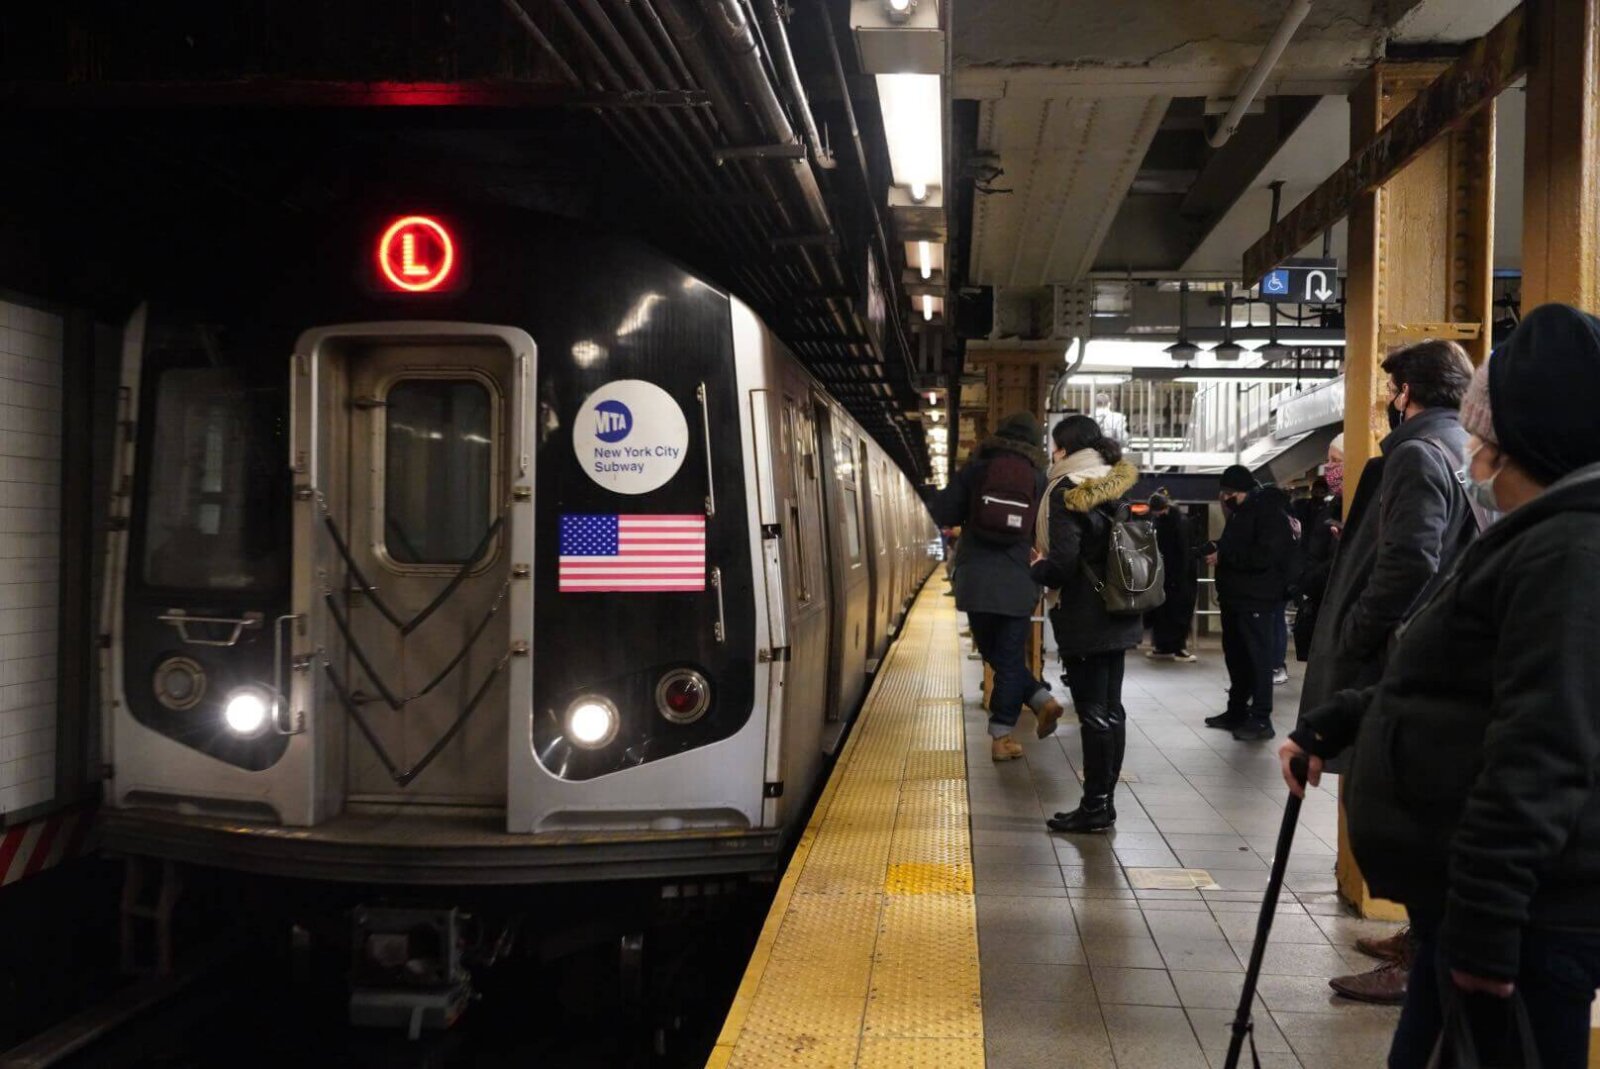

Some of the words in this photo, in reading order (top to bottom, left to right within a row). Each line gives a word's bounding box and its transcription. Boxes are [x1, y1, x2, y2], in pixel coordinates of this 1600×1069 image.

[402, 233, 431, 276] L
[594, 409, 627, 434] MTA
[594, 447, 622, 458] New
[624, 446, 652, 458] York
[655, 445, 679, 459] City
[594, 461, 645, 474] Subway
